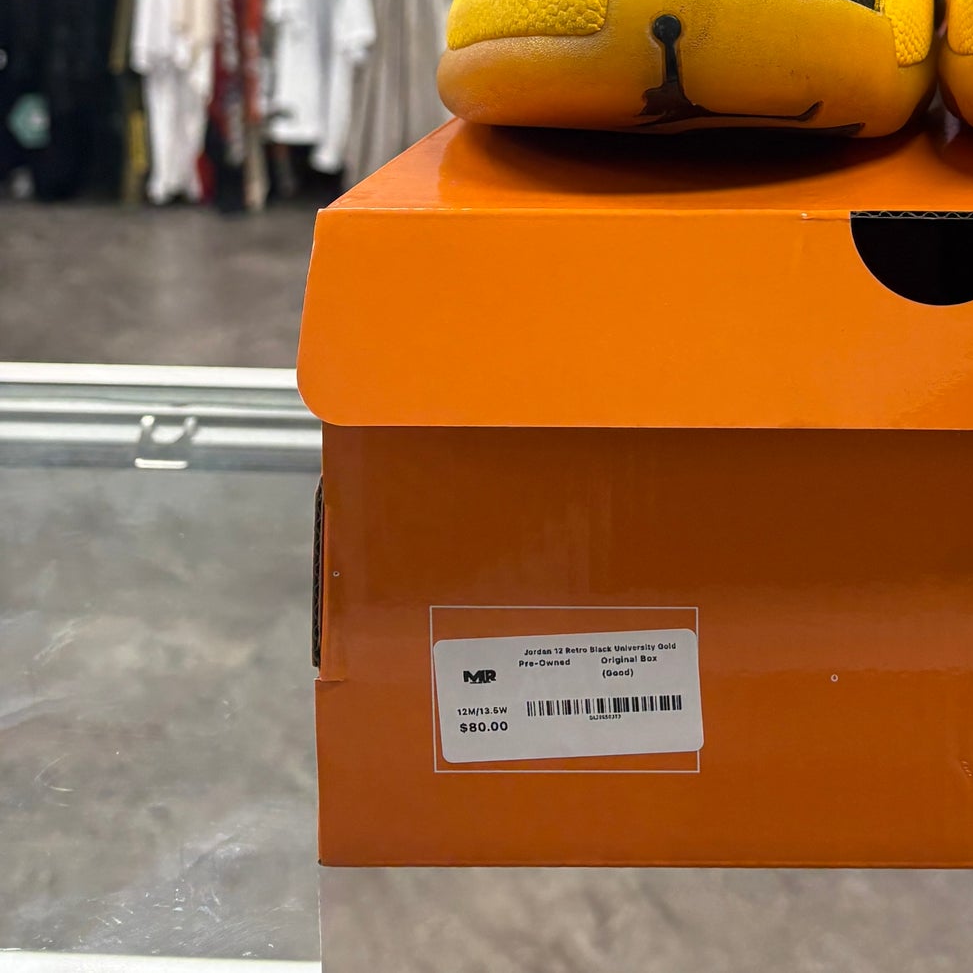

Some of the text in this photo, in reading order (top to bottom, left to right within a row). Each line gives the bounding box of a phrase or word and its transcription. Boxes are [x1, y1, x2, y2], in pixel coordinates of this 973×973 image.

[524, 648, 552, 656] Jordan
[566, 646, 588, 654] Retro
[590, 645, 612, 653] Black
[614, 643, 655, 653] University
[657, 642, 676, 650] Gold
[518, 658, 571, 668] Pre-Owned
[601, 655, 657, 665] Original Box
[463, 669, 497, 683] MR
[602, 668, 634, 678] (Good)
[457, 707, 508, 717] 12M/13.5W
[460, 721, 508, 733] $80.00
